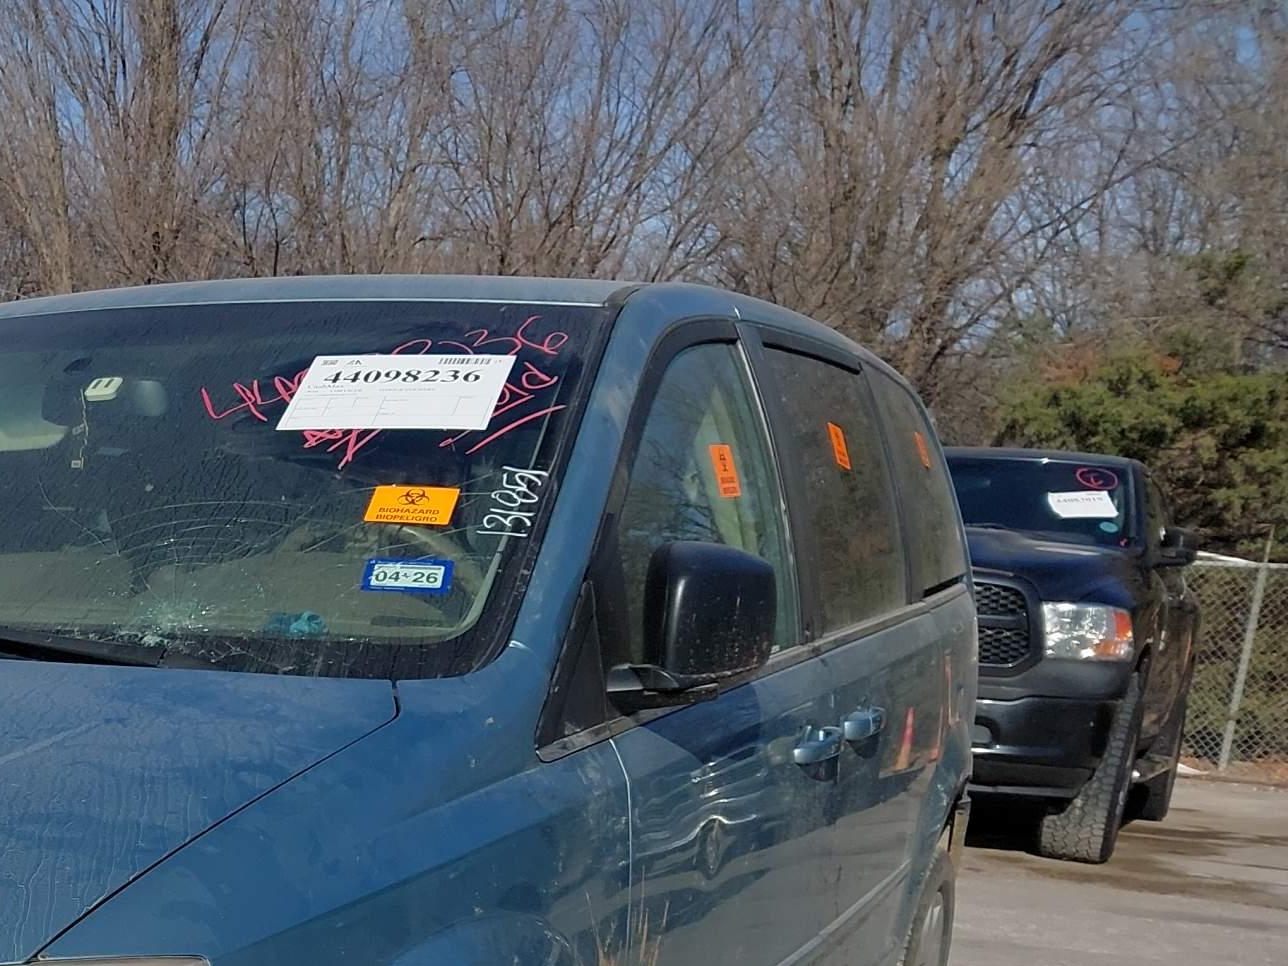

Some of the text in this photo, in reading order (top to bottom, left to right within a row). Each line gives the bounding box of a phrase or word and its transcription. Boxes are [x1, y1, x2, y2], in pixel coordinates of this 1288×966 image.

[323, 368, 483, 385] 44098236
[378, 507, 440, 515] BIOHAZARD
[375, 514, 438, 523] BIOPELIGRO
